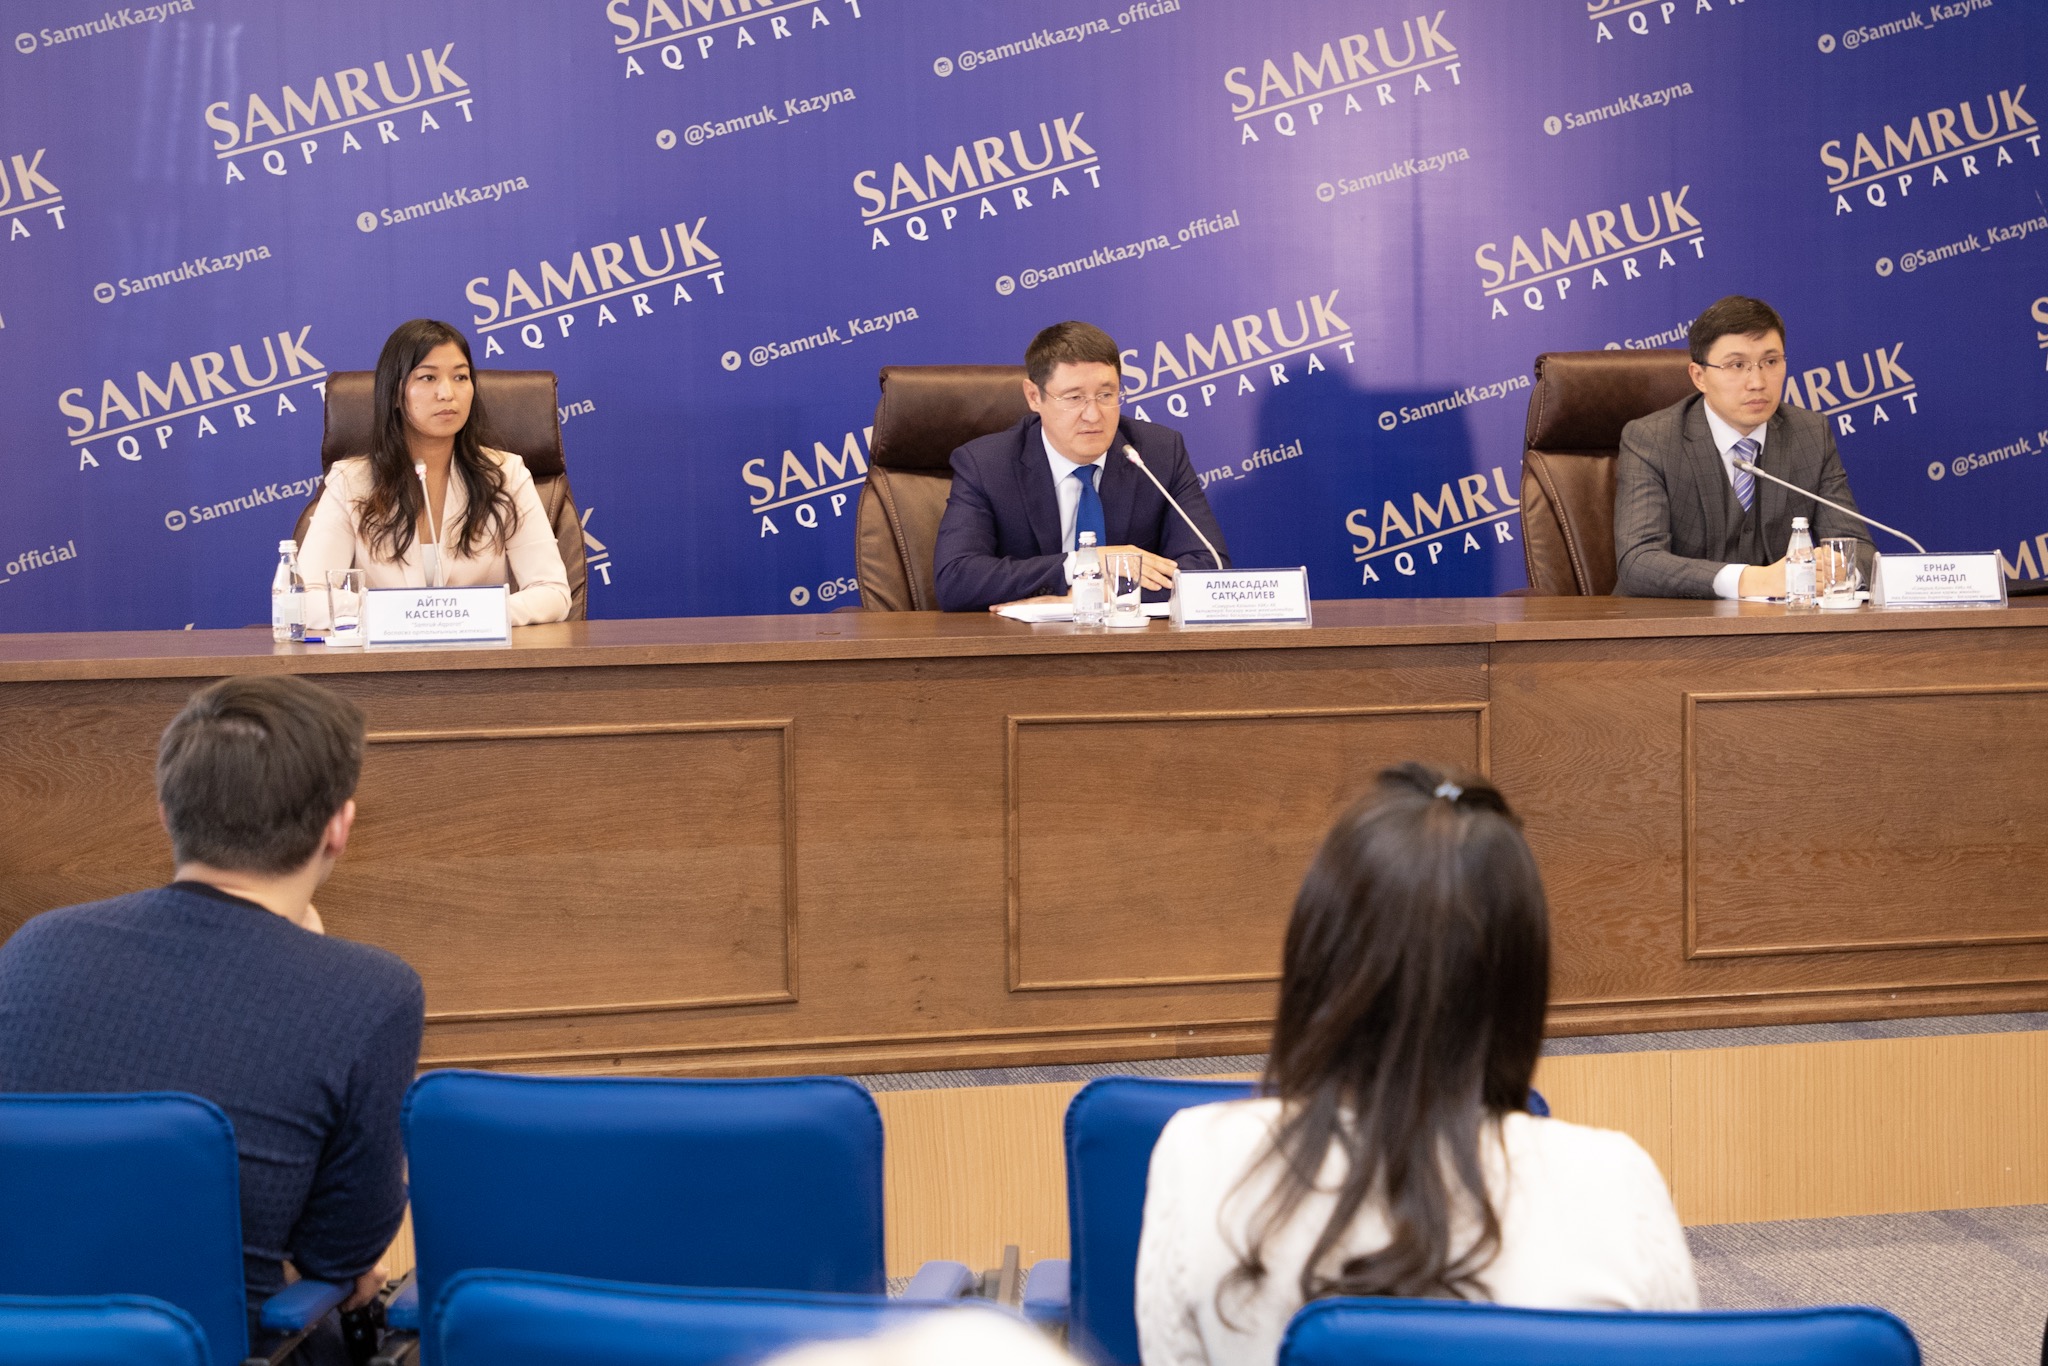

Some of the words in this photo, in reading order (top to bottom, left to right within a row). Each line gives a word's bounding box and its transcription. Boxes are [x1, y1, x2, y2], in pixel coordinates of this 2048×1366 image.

[40, 0, 195, 47] SamrukKazyna
[626, 0, 862, 78] AQPARAT
[958, 0, 1180, 71] @samrukkazyna_official
[1225, 10, 1457, 113] SAMRUK
[205, 43, 468, 150] SAMRUK
[684, 88, 856, 145] @Samruk_Kazyna
[1241, 63, 1462, 145] AQPARAT
[1564, 83, 1694, 130] SamrukKazyna
[1820, 84, 2037, 186] SAMRUK
[225, 98, 474, 184] AQPARAT
[853, 112, 1096, 217] SAMRUK
[1338, 148, 1470, 196] SamrukKazyna
[1836, 134, 2042, 216] AQPARAT
[380, 176, 529, 226] SamrukKazyna
[871, 165, 1101, 250] AQPARAT
[1475, 185, 1701, 289] SAMRUK
[118, 245, 271, 297] SamrukKazyna
[465, 217, 720, 326] SAMRUK
[1020, 210, 1240, 289] @samrukkazyna_official
[1491, 236, 1705, 319] AQPARAT
[1900, 216, 2048, 272] @Samruk_Kazyna
[485, 271, 725, 358] AQPARAT
[749, 307, 919, 366] @Samruk_Kazyna
[1120, 290, 1352, 395] SAMRUK
[1625, 319, 1697, 349] Samruk
[58, 325, 325, 437] SAMRUK
[1135, 341, 1356, 423] AQPARAT
[1400, 375, 1530, 424] SamrukKazyna
[1952, 430, 2048, 477] @Samruk_K
[1346, 462, 1521, 554] SAMRU
[1206, 580, 1279, 589] АЛМАСАДАМ
[1362, 521, 1514, 586] AQPAR
[1924, 563, 1956, 572] ЕРНАР
[405, 609, 470, 619] КАСЕНОВА
[1211, 591, 1275, 601] САТҚАЛИЕВ
